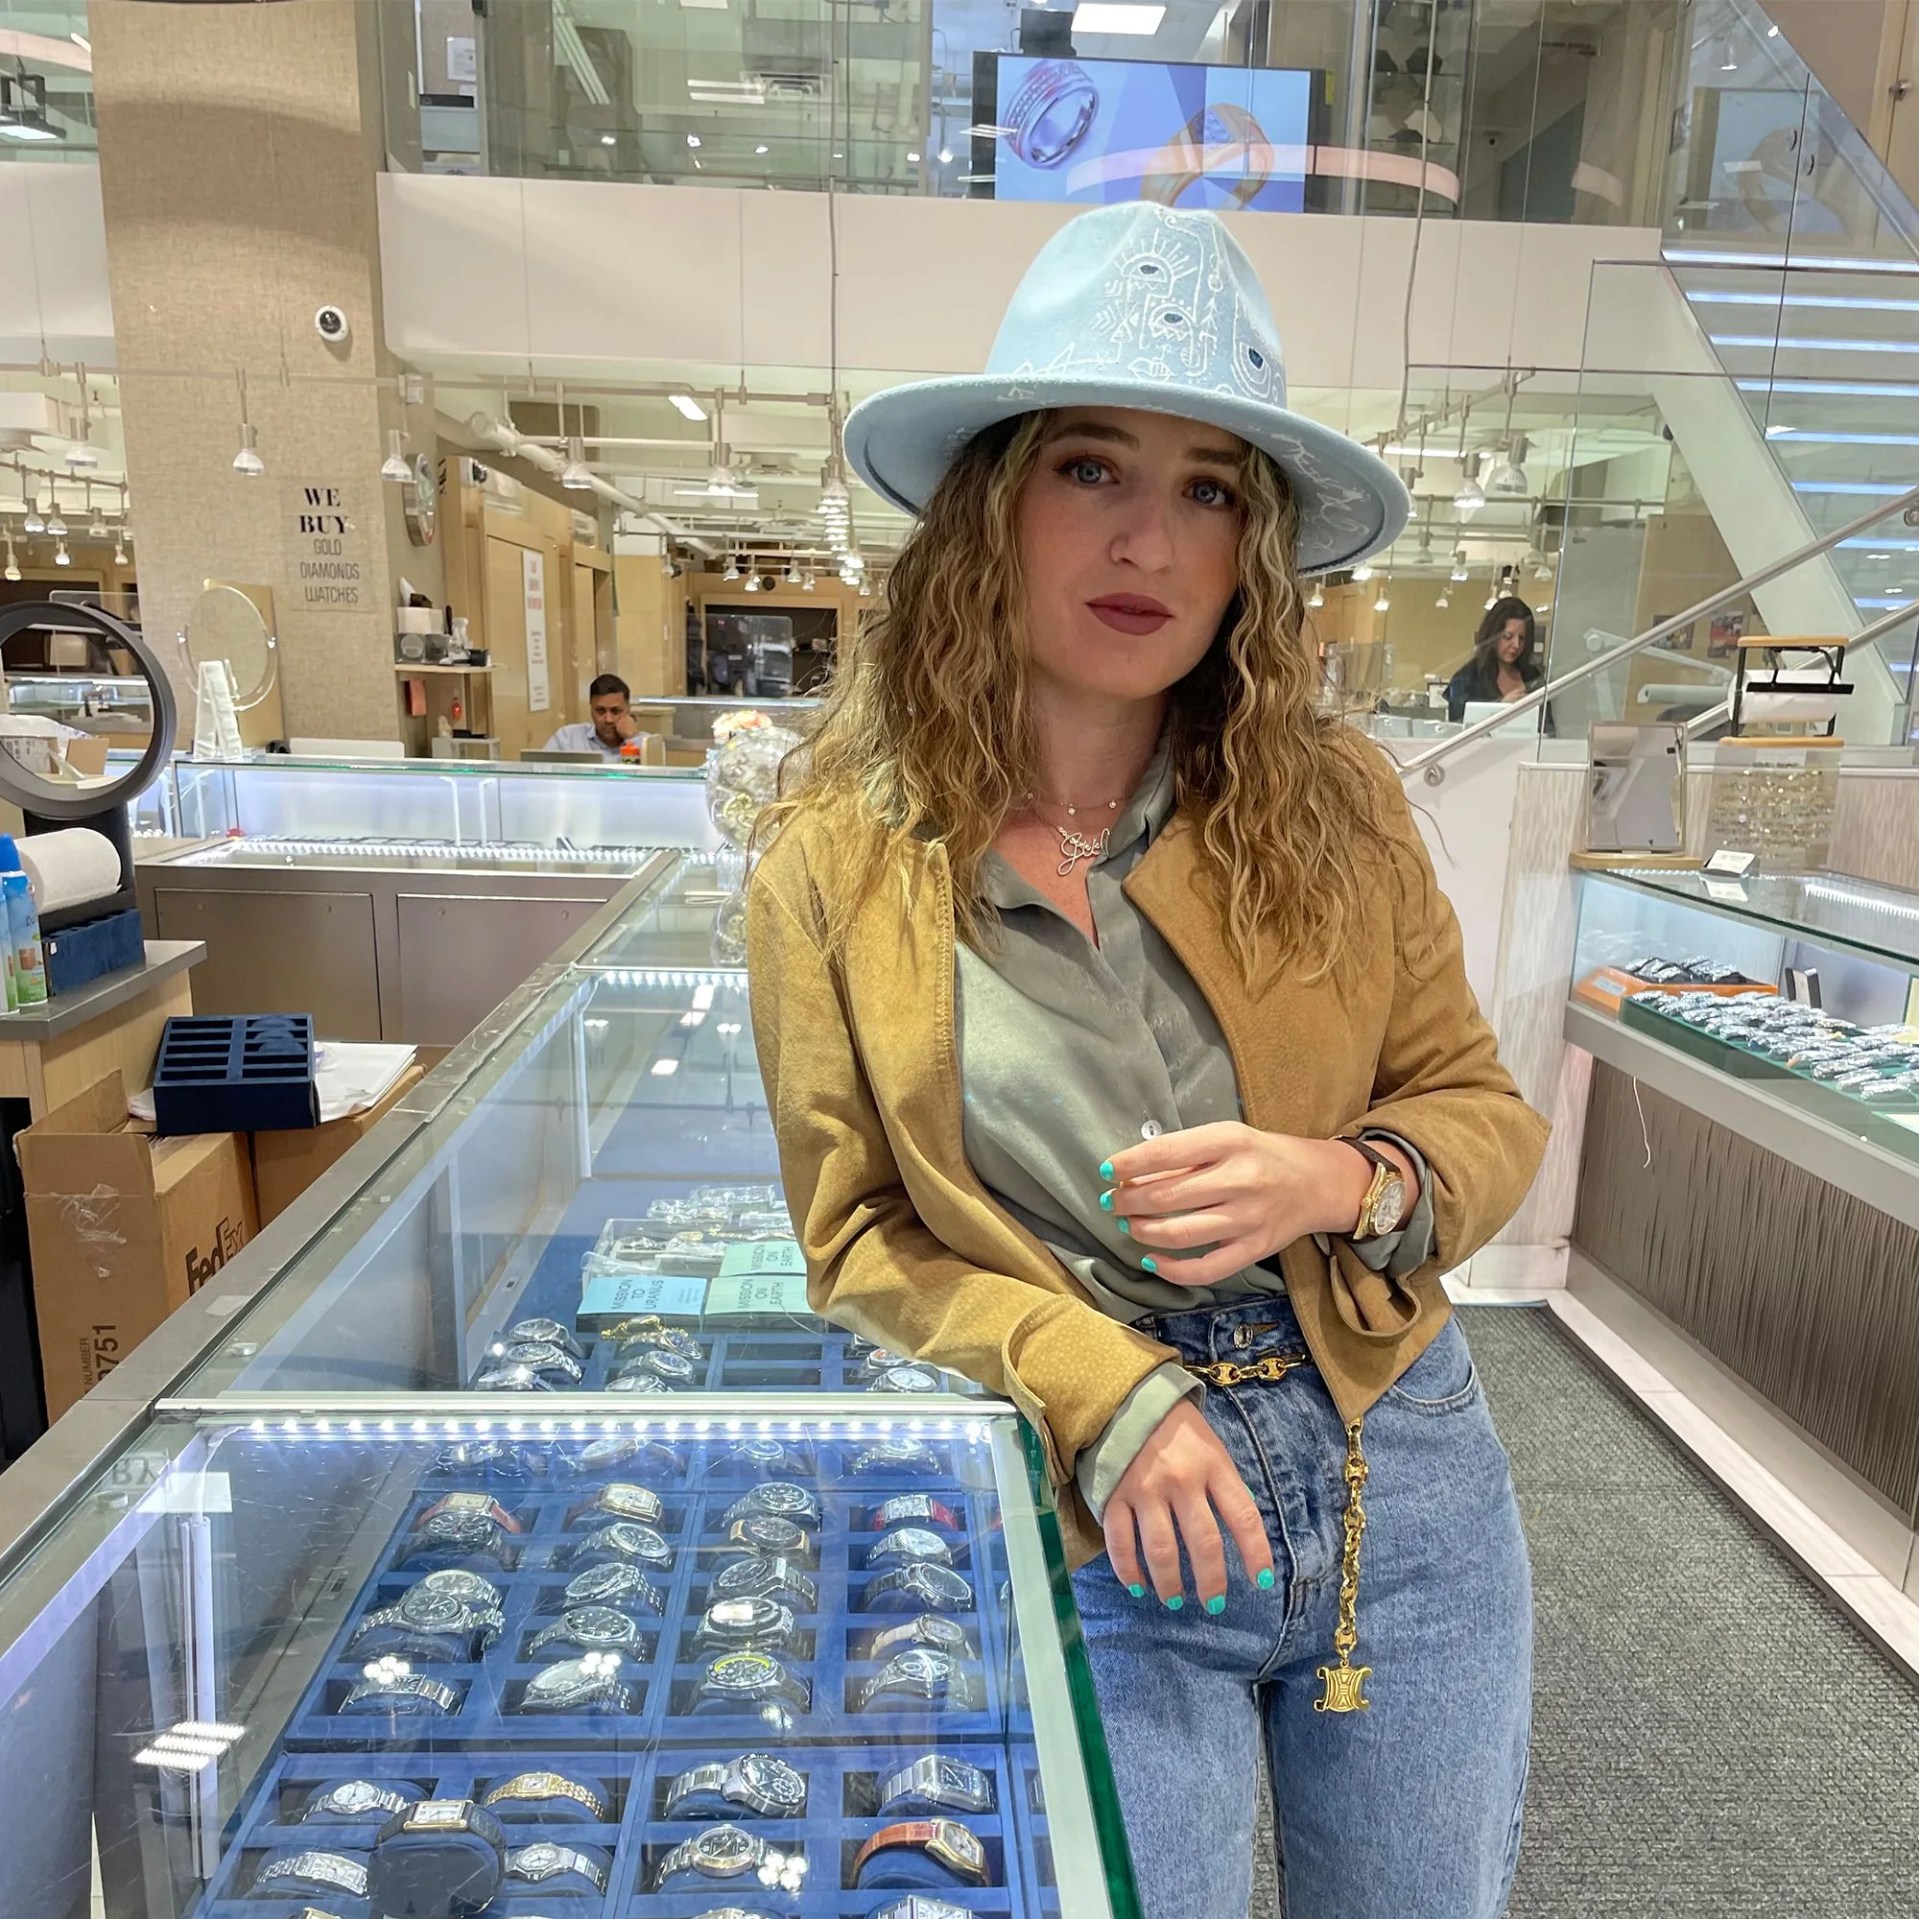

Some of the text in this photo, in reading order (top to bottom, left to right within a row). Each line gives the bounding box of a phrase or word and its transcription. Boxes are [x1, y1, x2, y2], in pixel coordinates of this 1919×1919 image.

[304, 487, 341, 507] WE
[299, 515, 349, 535] BUY
[313, 538, 342, 555] GOLD
[300, 562, 360, 580] DIAMONDS
[304, 586, 359, 604] WATCHES
[185, 1216, 244, 1298] FedEx
[611, 1279, 634, 1310] MISSION
[631, 1288, 646, 1300] TO
[644, 1280, 665, 1310] URANUS
[736, 1278, 754, 1309] MISSION
[754, 1287, 769, 1299] ON
[769, 1282, 785, 1305] EARTH
[79, 1337, 93, 1387] NUMBER
